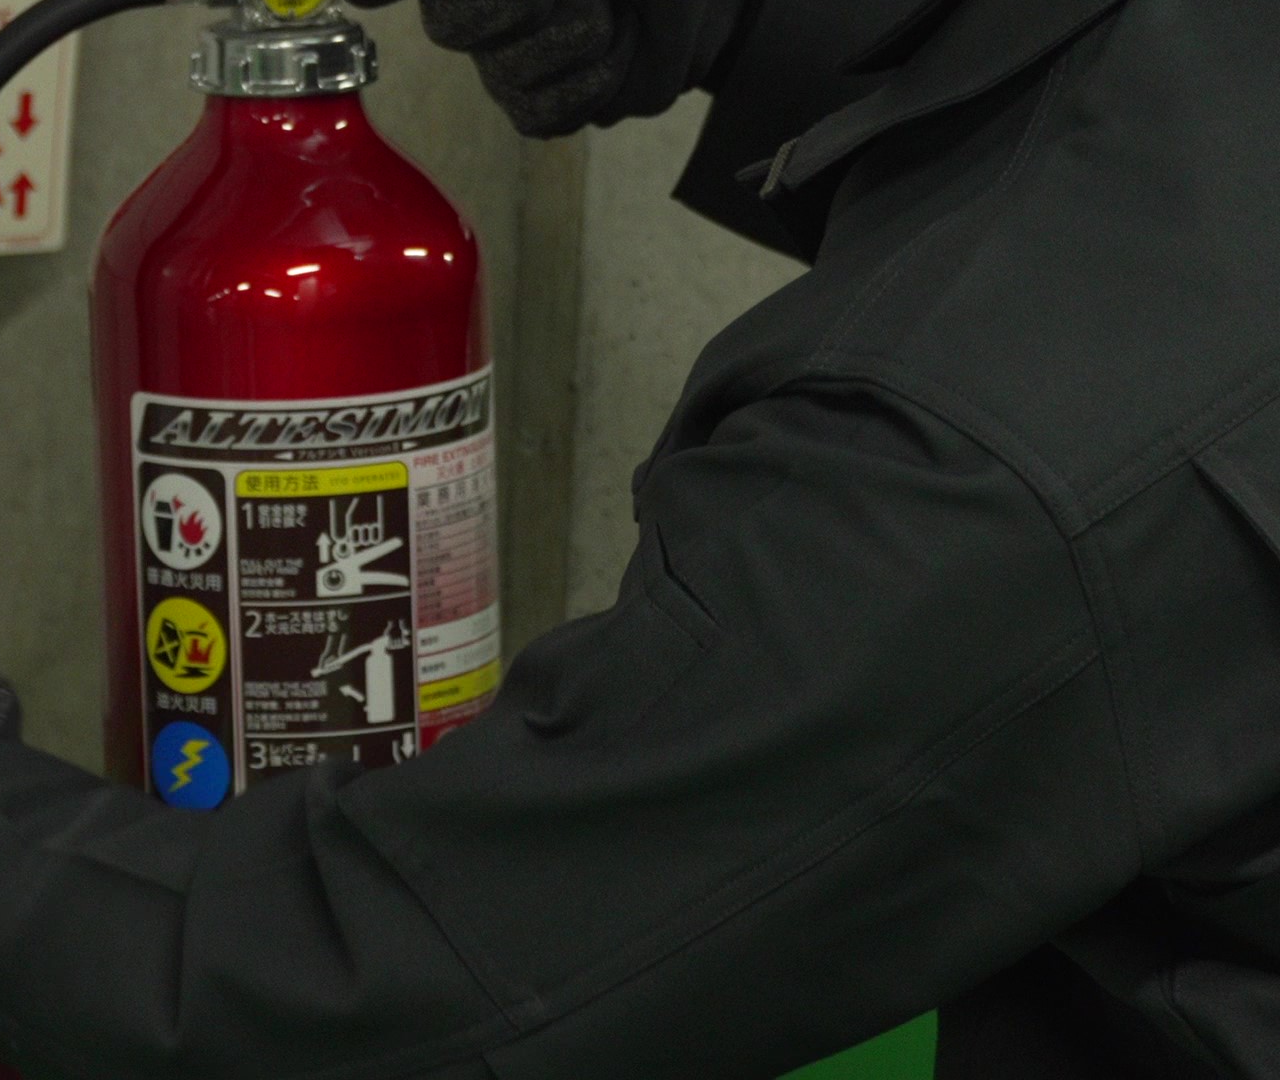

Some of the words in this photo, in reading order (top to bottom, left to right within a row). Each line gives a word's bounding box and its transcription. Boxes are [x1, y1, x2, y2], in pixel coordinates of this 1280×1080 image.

[245, 473, 320, 493] 使用方法
[241, 501, 254, 531] 1
[244, 609, 263, 639] 2
[249, 740, 267, 770] 3
